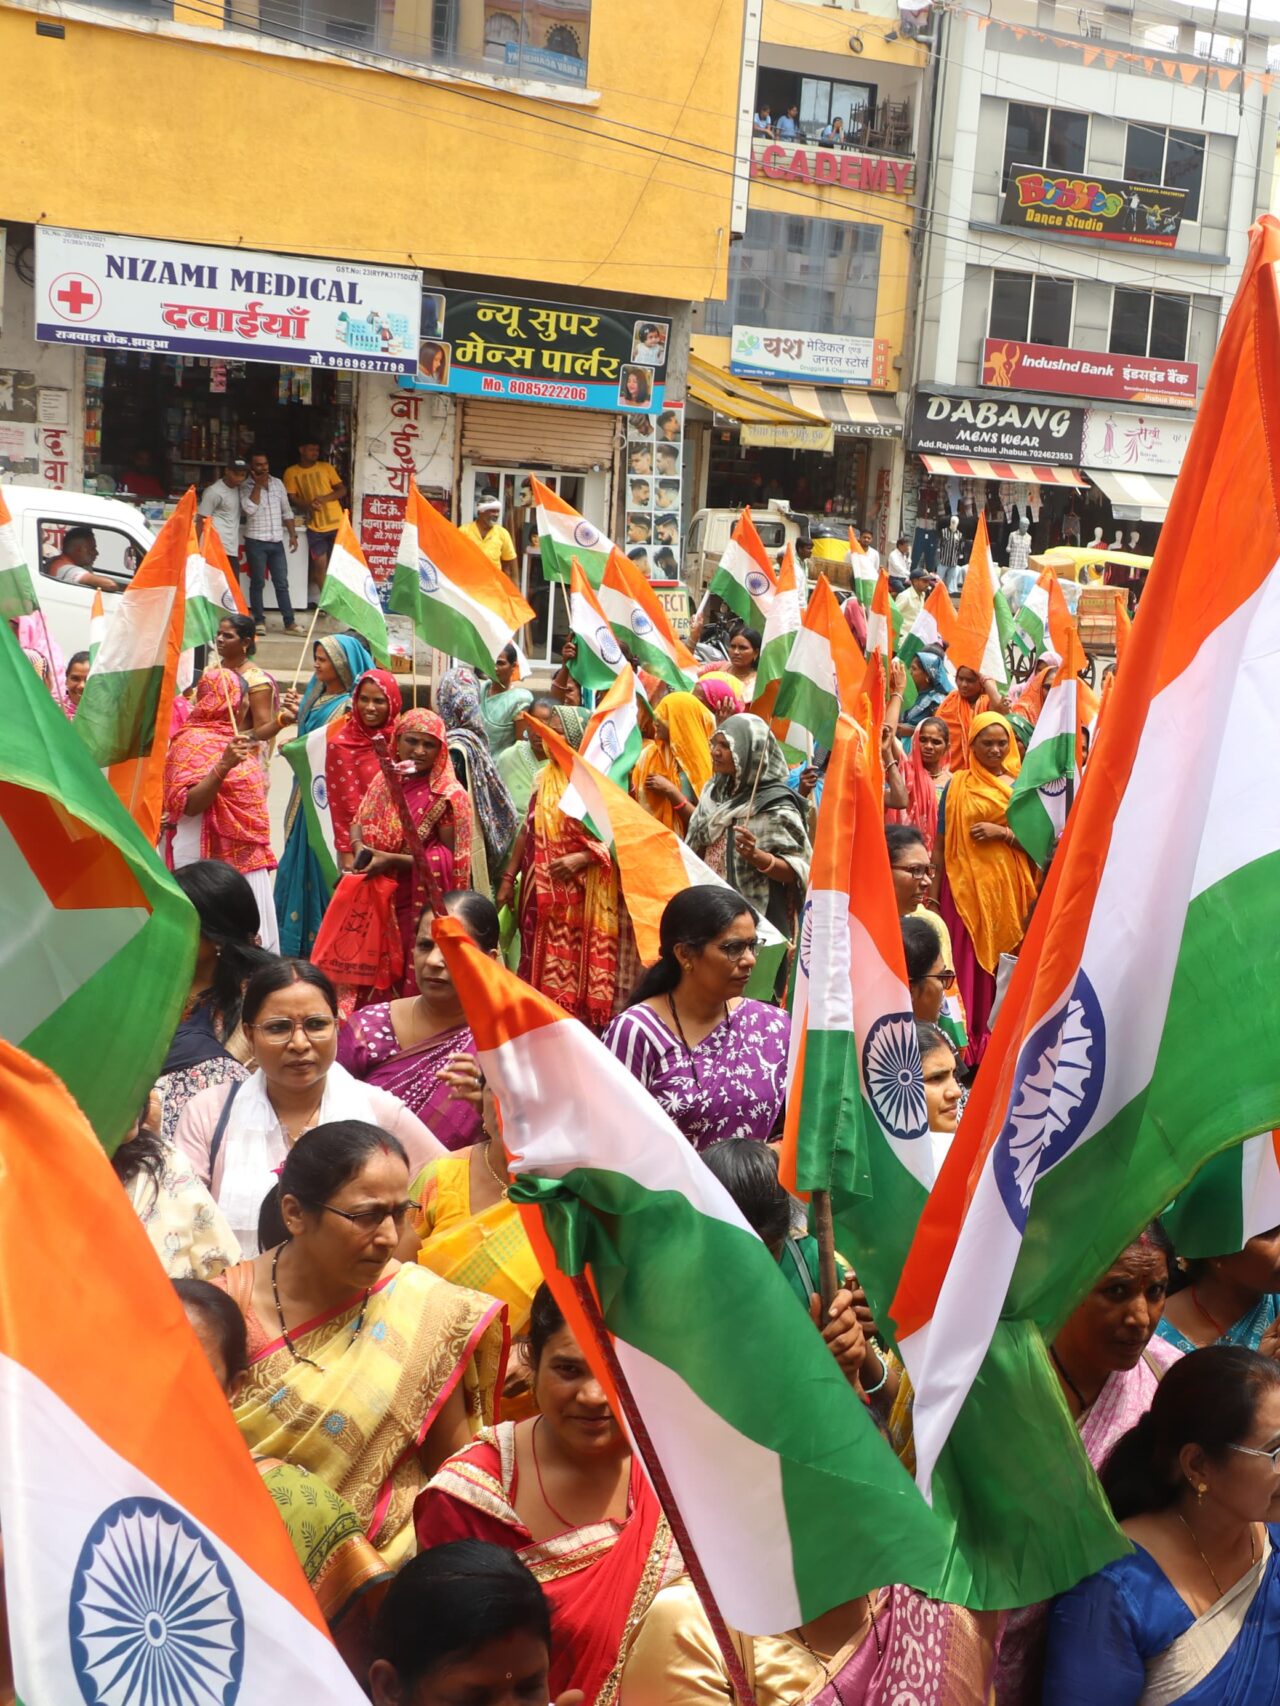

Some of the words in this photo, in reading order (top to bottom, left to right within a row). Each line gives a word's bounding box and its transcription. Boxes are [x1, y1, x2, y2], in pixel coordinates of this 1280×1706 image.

[1015, 174, 1123, 217] Bubbles
[1025, 208, 1062, 226] Dance
[1065, 216, 1104, 231] Studio
[105, 254, 219, 290] NIZAMI
[230, 267, 363, 305] MEDICAL
[160, 301, 311, 340] दवाईयाँ
[476, 301, 527, 339] न्यू
[528, 308, 601, 342] सुपर
[455, 332, 535, 369] मेन्स
[541, 347, 620, 379] पार्लर
[807, 338, 845, 354] मेडिकल
[328, 357, 405, 373] 9669627796
[812, 355, 842, 366] जनरल
[1021, 354, 1081, 373] IndusInd
[1081, 363, 1114, 377] Bank
[1122, 364, 1165, 383] इंडसइंड
[482, 376, 504, 392] Mo.
[509, 379, 587, 401] 8085222206
[926, 397, 1071, 438] DABANG
[973, 445, 997, 454] chauk
